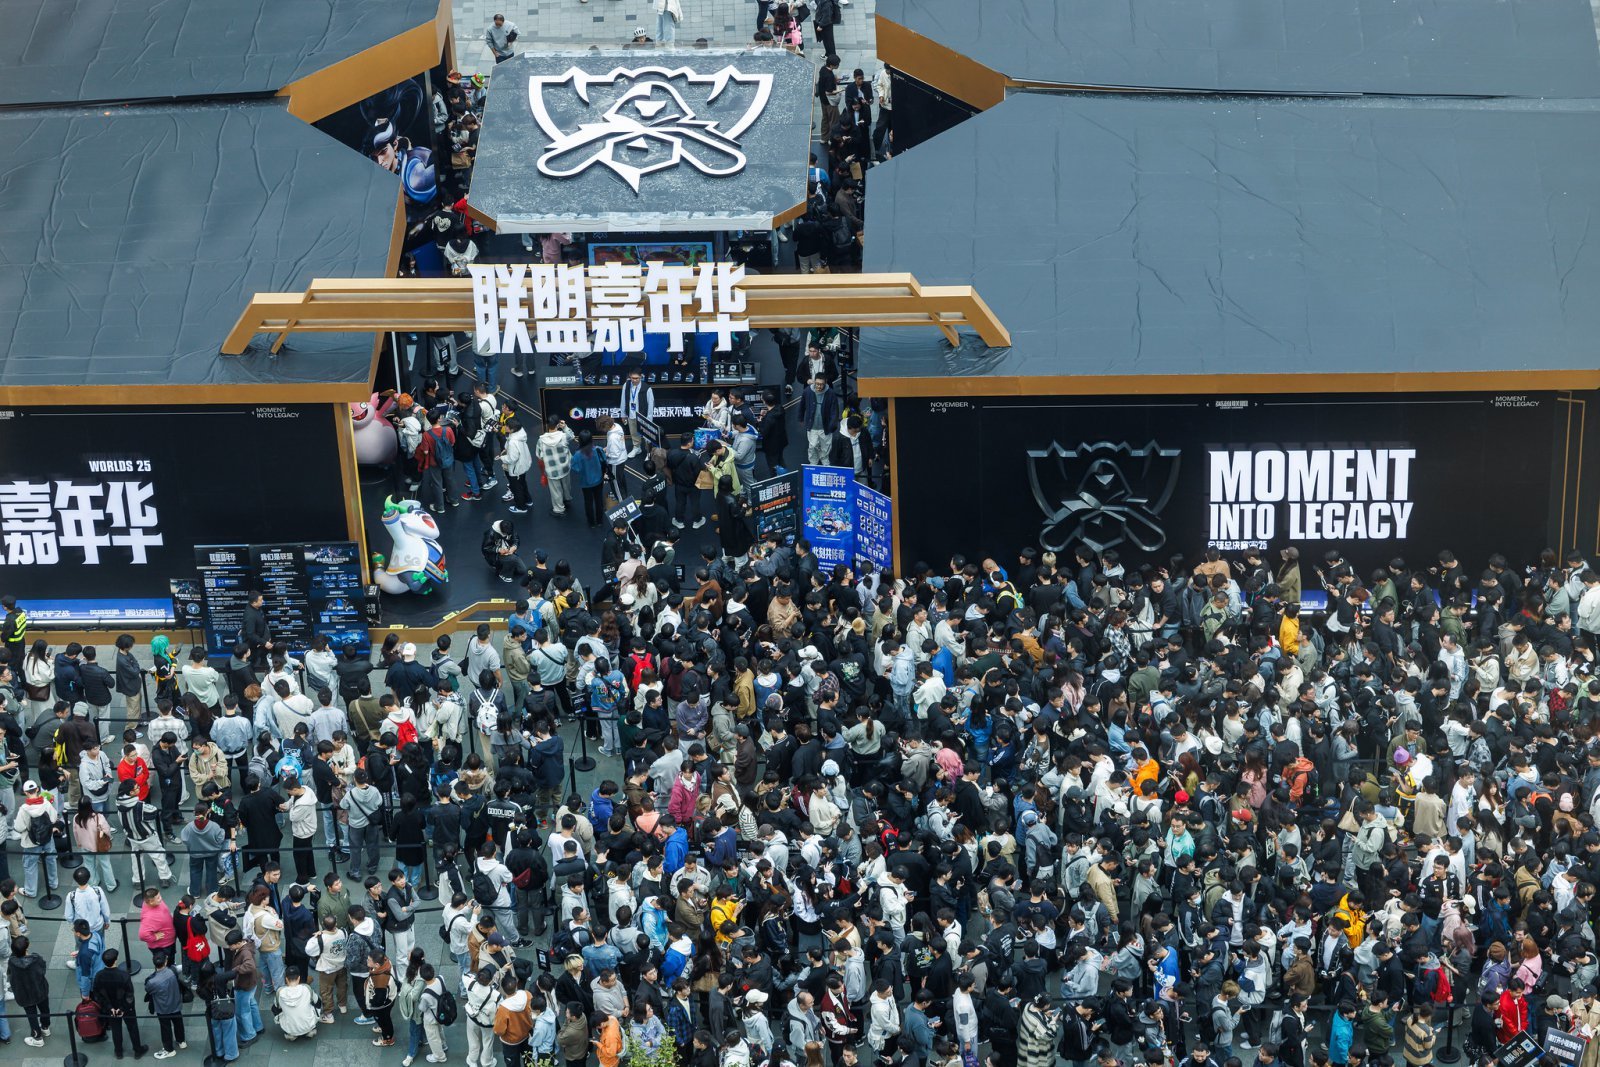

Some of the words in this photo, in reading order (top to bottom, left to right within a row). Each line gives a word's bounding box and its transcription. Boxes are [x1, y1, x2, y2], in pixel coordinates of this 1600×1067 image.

[467, 261, 750, 354] 联盟嘉年华
[930, 401, 969, 409] NOVEMBER
[88, 460, 133, 473] WORLDS
[136, 460, 152, 472] 25
[1208, 449, 1416, 502] MOMENT
[0, 481, 164, 565] 嘉年华
[1209, 503, 1275, 540] INTO
[1288, 502, 1414, 540] LEGACY
